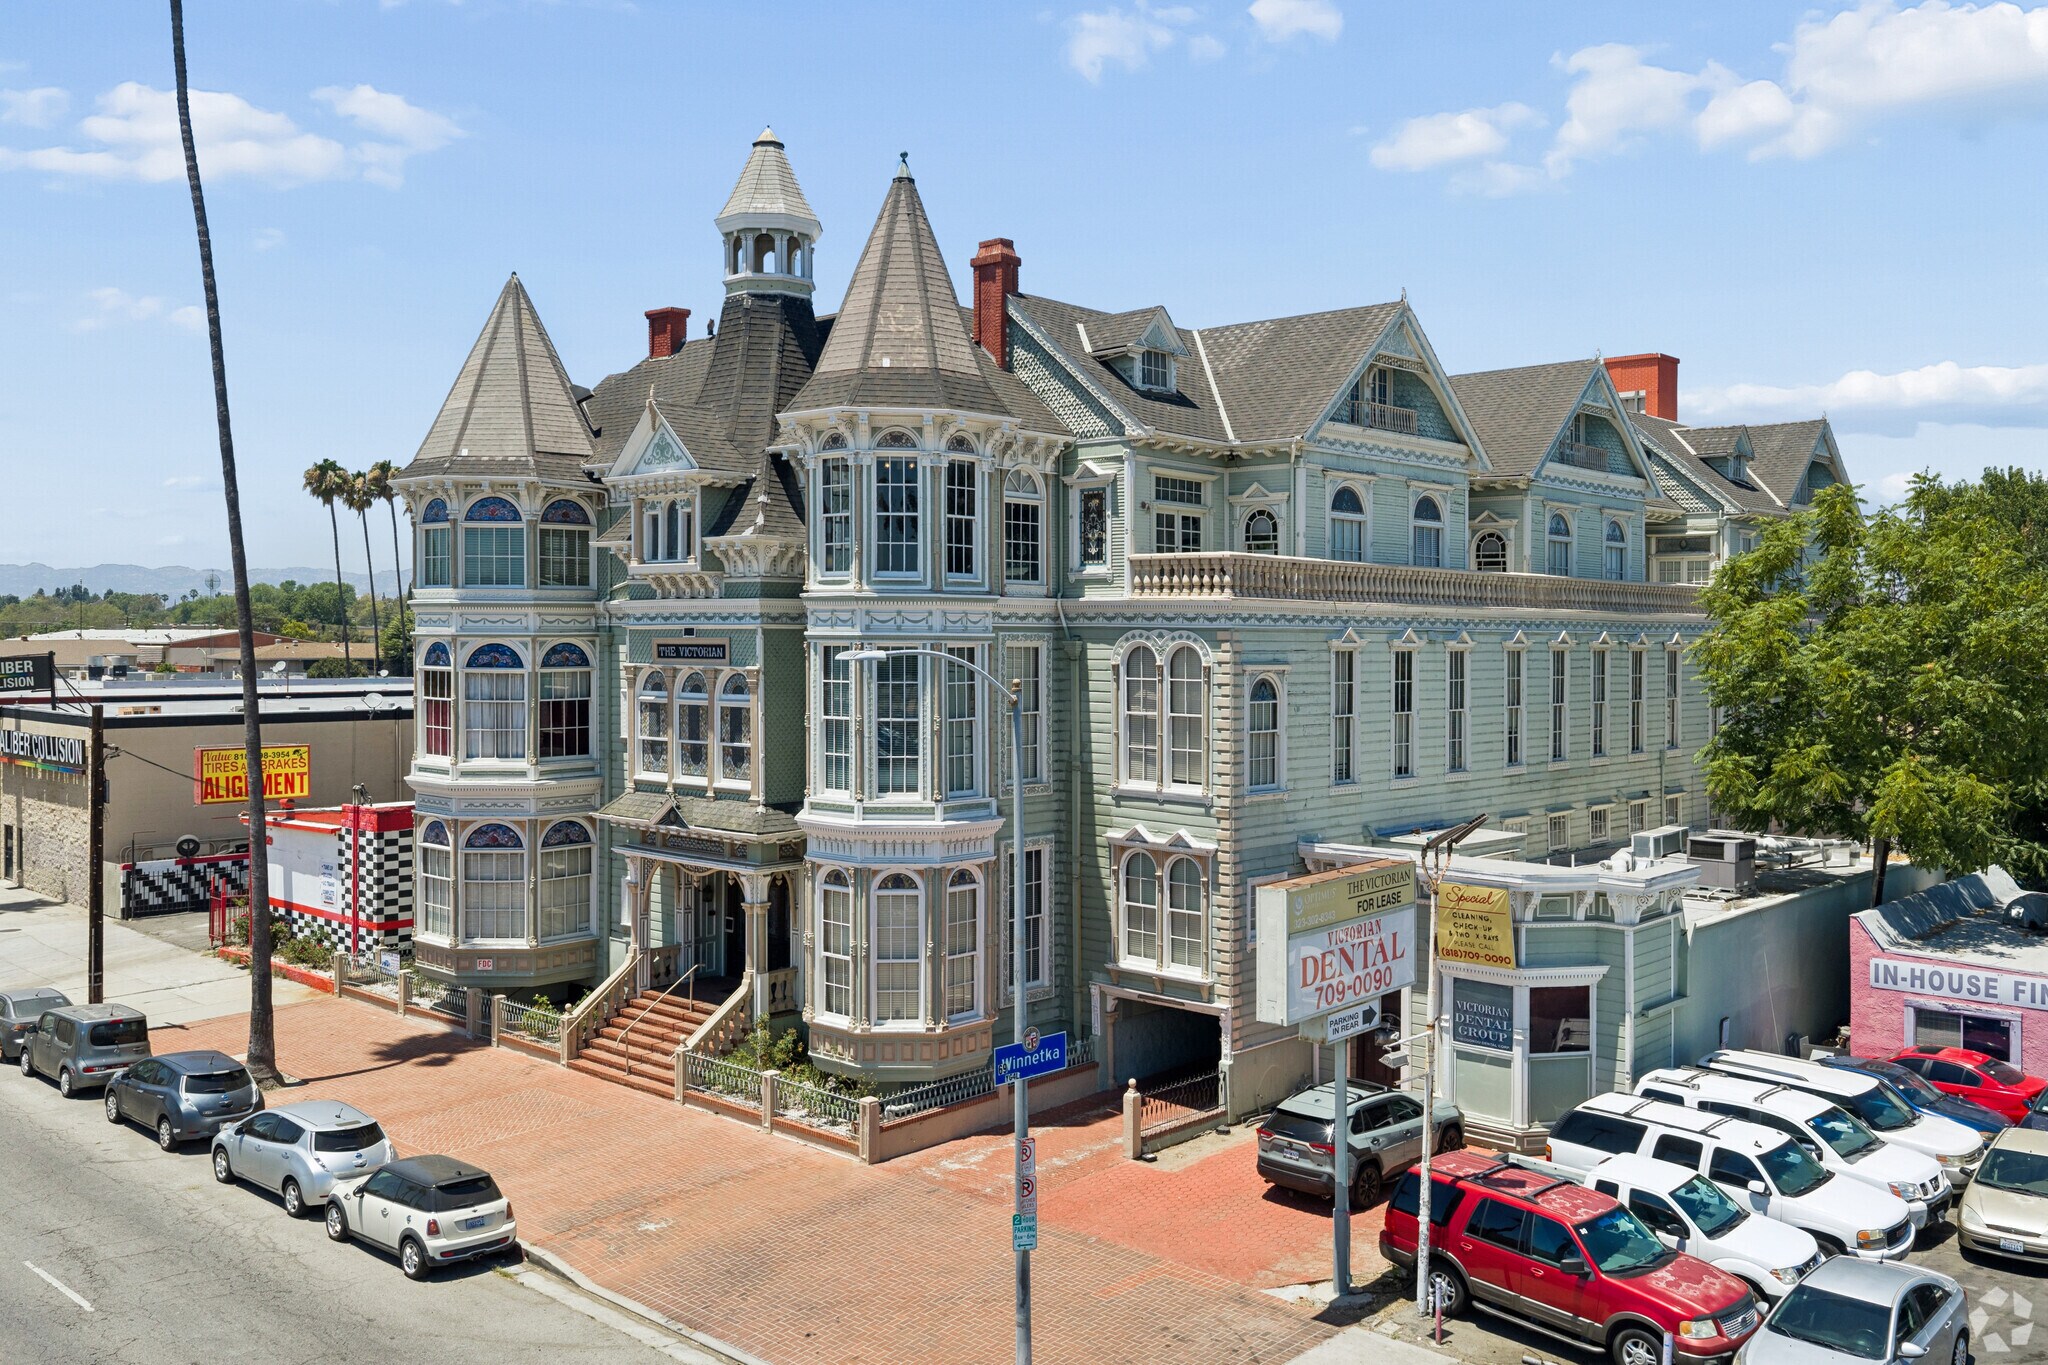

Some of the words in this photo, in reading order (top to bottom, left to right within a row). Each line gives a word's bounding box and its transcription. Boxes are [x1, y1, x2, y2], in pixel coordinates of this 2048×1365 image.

[659, 646, 676, 657] THE
[679, 646, 723, 658] VICTORIAN
[0, 660, 34, 674] IBER
[31, 735, 83, 765] COLLISION
[203, 751, 233, 762] Value
[204, 761, 239, 773] TIRES
[261, 757, 307, 771] BRAKES
[1347, 880, 1365, 896] THE
[1366, 869, 1411, 893] VICTORIAN
[1357, 899, 1375, 914] FOR
[1377, 890, 1402, 909] LEASE
[1446, 886, 1494, 907] Special
[1452, 912, 1492, 923] CLEANING,
[1328, 918, 1382, 948] VICTORIAN
[1454, 940, 1475, 949] PLEASE
[1479, 943, 1495, 951] CALL
[478, 960, 492, 968] FDC
[1300, 931, 1405, 989] DENTAL
[1441, 947, 1512, 965] (818)709-0090
[1315, 966, 1393, 1010] 709-0090
[1874, 963, 1999, 999] IN-HOUSE
[1456, 1000, 1510, 1018] VICTORIAN
[1330, 1012, 1360, 1028] PARKING
[1332, 1024, 1340, 1035] IN
[1341, 1020, 1360, 1034] REAR
[1455, 1012, 1511, 1032] DENTAL
[1458, 1025, 1508, 1042] GROUP
[1002, 1048, 1060, 1071] Winnetka
[1015, 1215, 1020, 1224] 2
[1014, 1225, 1036, 1233] PARKING
